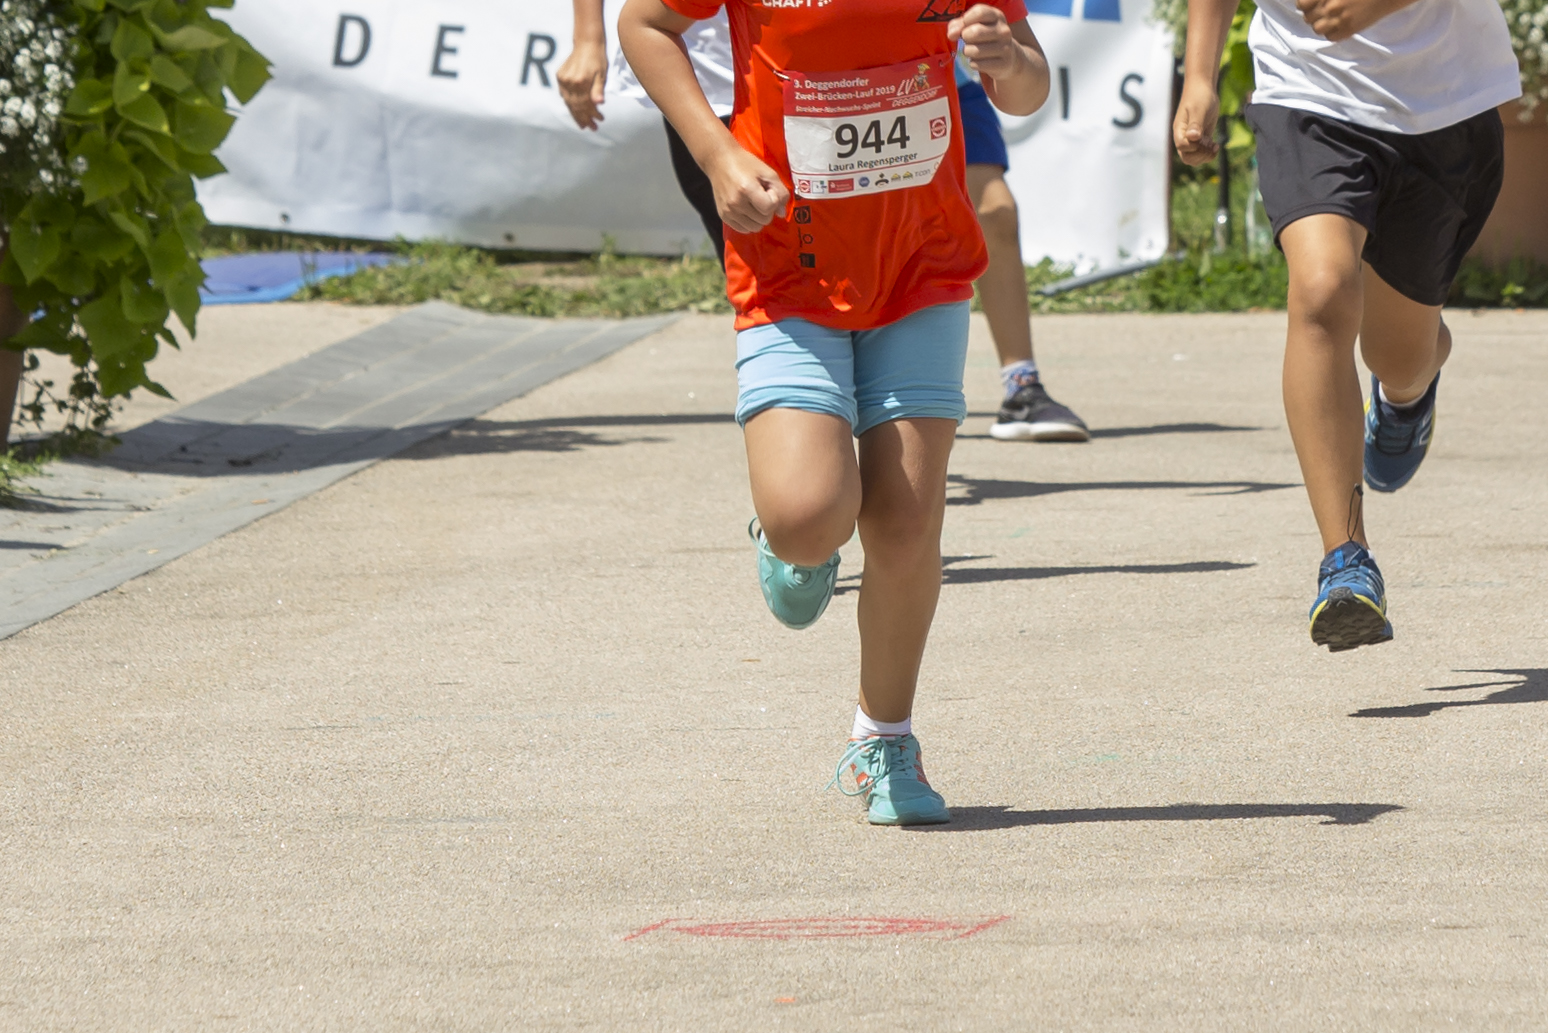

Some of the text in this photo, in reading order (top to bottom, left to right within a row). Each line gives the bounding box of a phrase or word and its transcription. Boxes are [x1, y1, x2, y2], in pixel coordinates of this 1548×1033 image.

[332, 13, 557, 88] DER
[793, 77, 870, 91] 3. Deggendorfer
[794, 85, 897, 101] Zwei-Brücken-Lauf 2019
[834, 115, 911, 159] 944
[828, 152, 919, 172] Laura Regensperger
